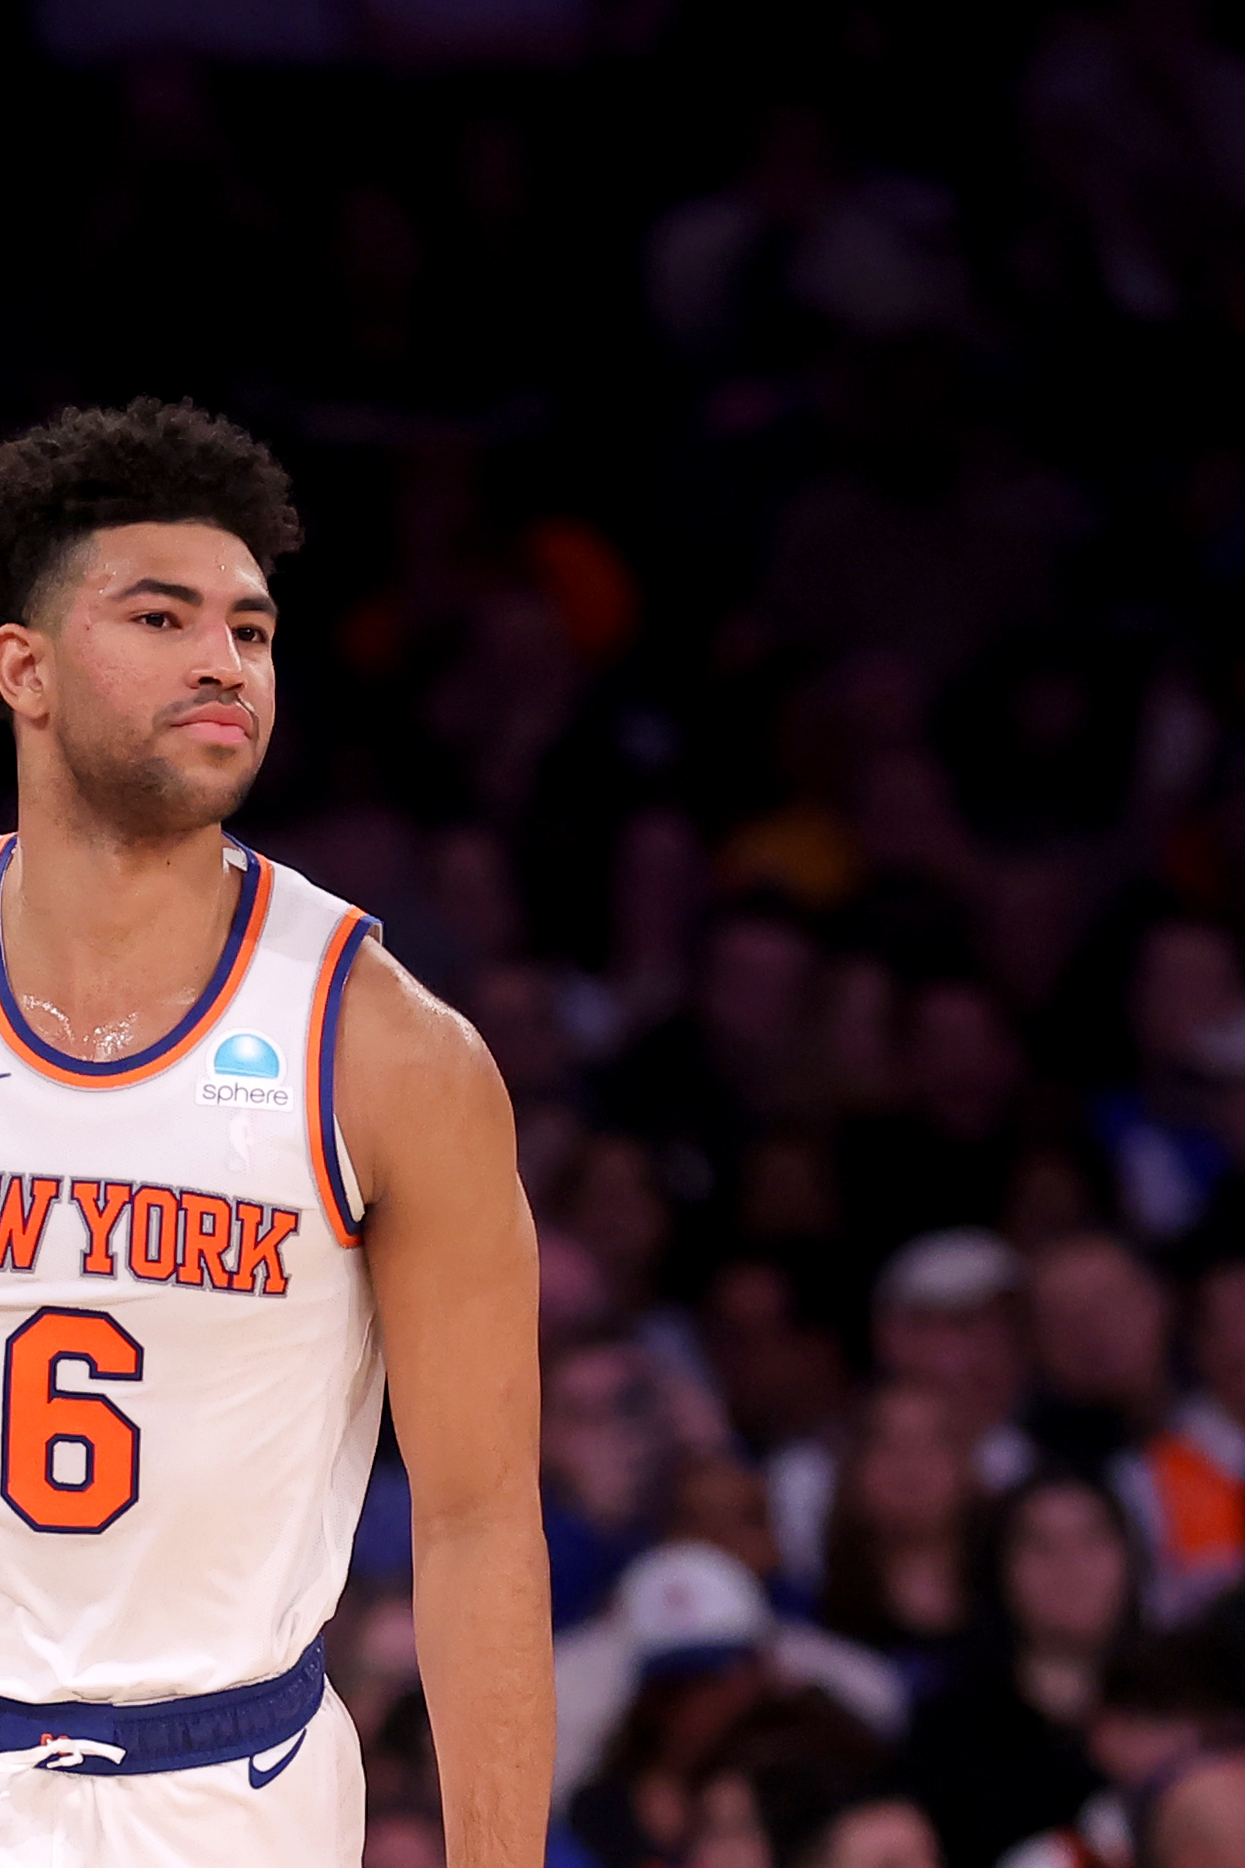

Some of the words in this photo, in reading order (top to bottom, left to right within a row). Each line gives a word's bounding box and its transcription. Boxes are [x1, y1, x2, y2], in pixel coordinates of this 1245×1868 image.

[202, 1082, 288, 1106] sphere
[70, 1180, 302, 1297] YORK
[0, 1306, 144, 1534] 6
